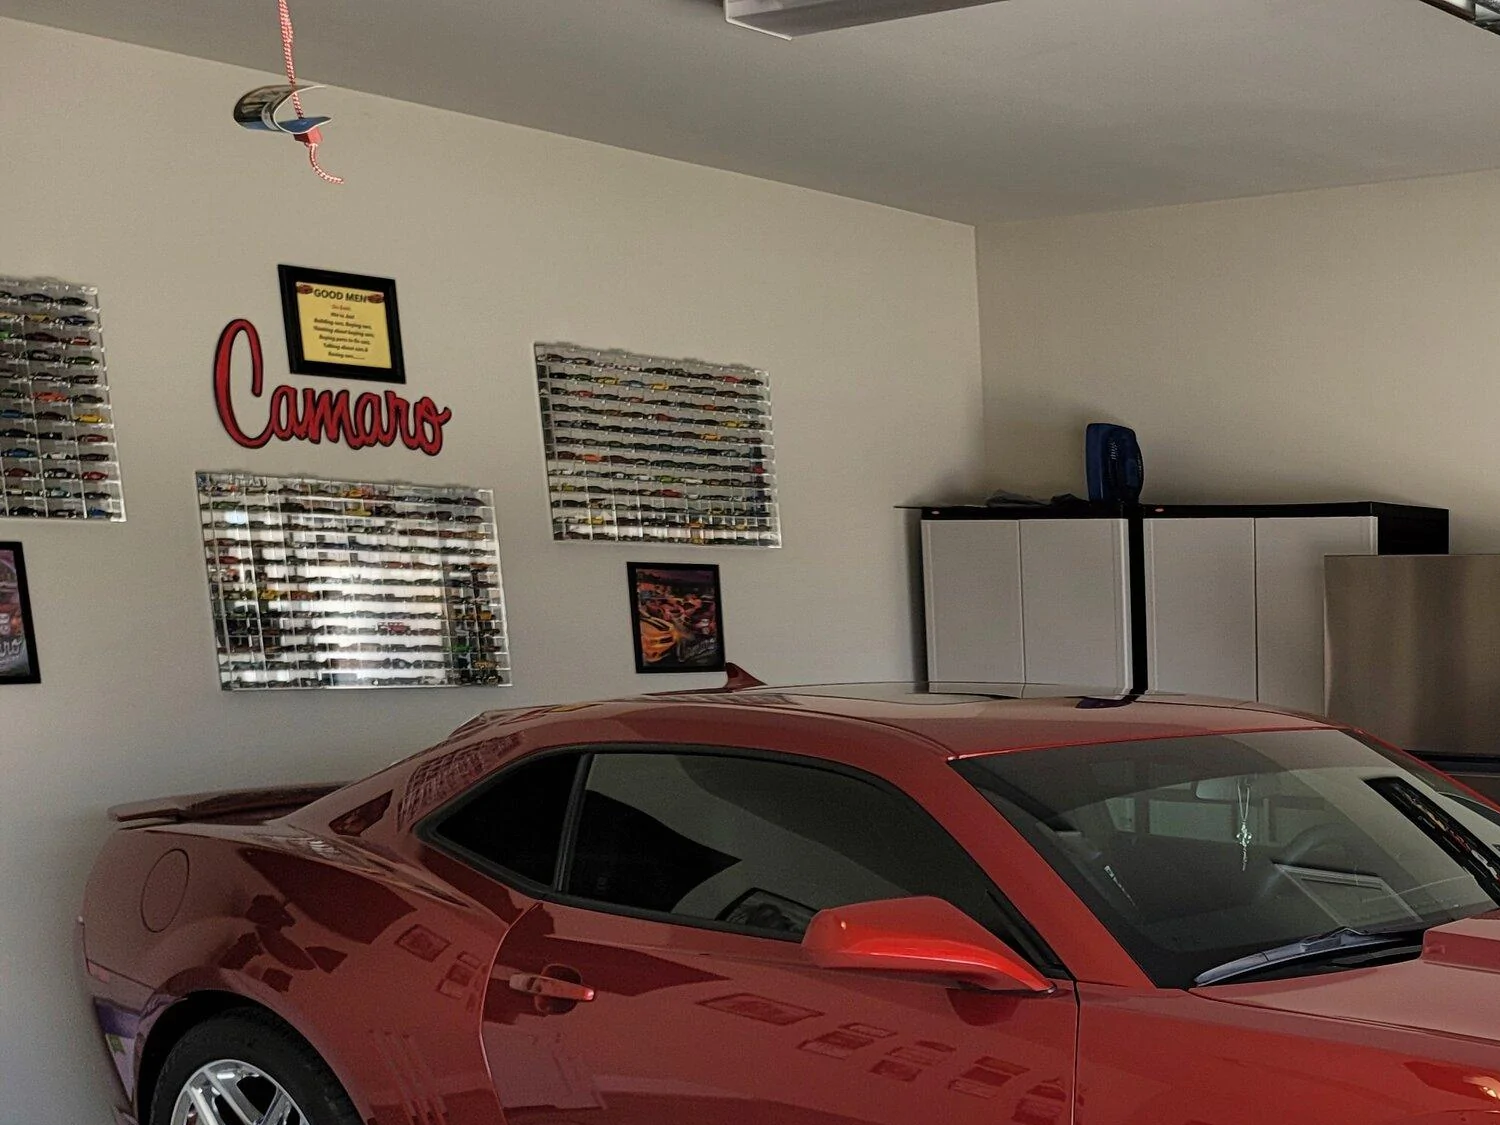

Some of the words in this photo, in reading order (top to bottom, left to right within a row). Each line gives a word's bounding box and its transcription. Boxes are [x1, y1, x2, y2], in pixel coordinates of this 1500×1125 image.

[314, 288, 344, 301] GOOD
[345, 293, 367, 304] MEN
[213, 318, 452, 456] Camaro
